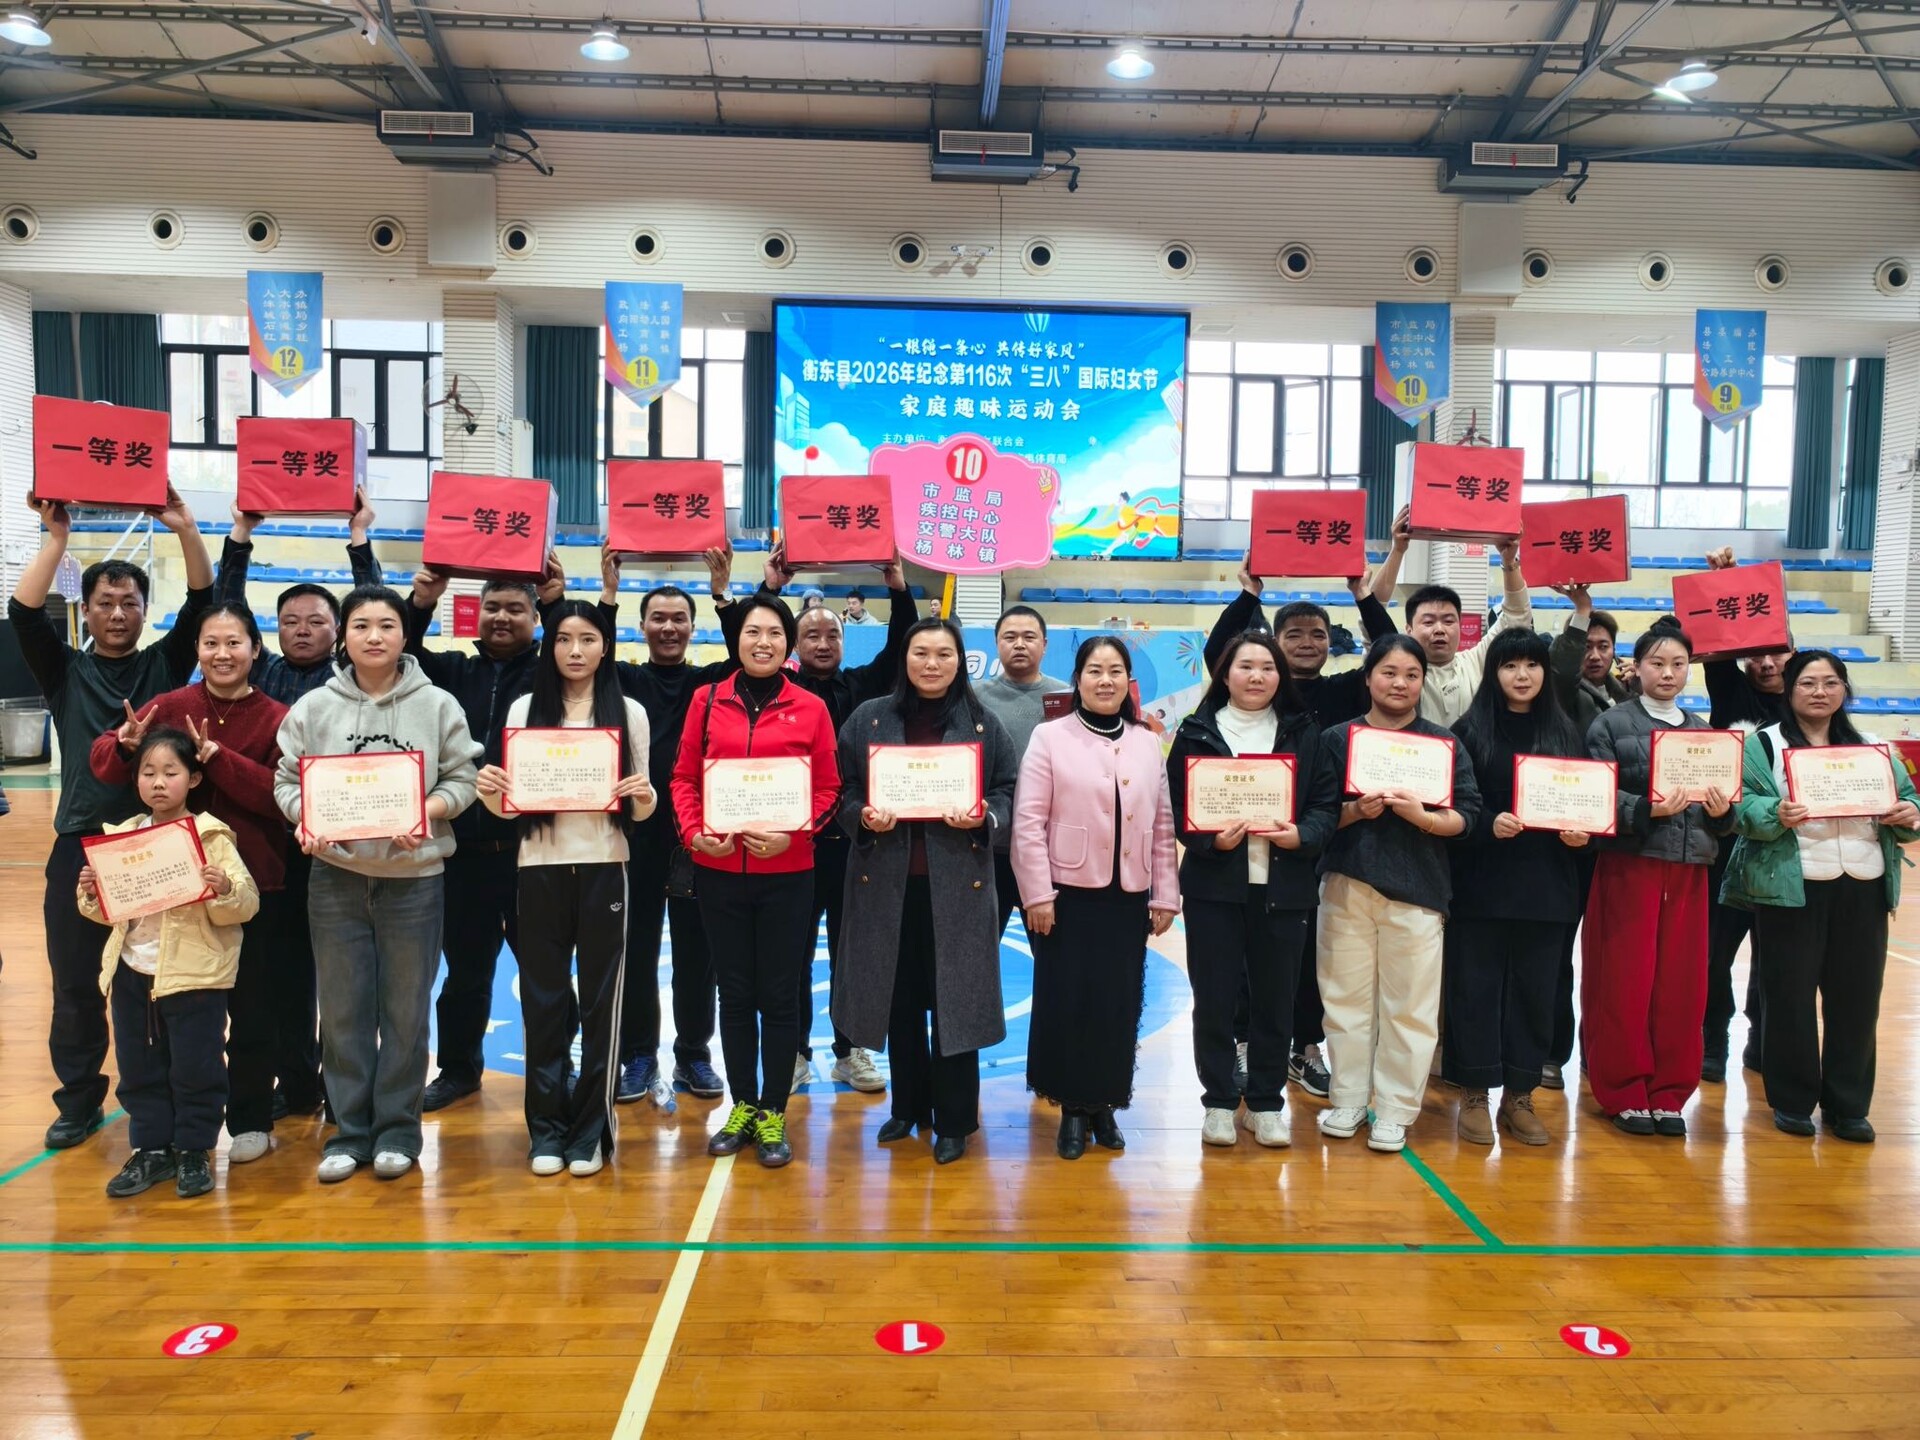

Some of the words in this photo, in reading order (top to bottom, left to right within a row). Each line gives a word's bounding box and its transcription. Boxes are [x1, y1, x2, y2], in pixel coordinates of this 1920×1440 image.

[263, 288, 307, 299] 人大办
[279, 348, 296, 368] 12
[635, 359, 650, 378] 11
[1403, 378, 1421, 397] 10
[1720, 384, 1733, 403] 9
[899, 393, 1081, 421] 家庭趣味运动会
[53, 437, 152, 468] 一等奖
[252, 450, 339, 477] 一等奖
[953, 447, 983, 481] 10
[923, 482, 1003, 507] 市监局
[1427, 475, 1510, 502] 一等奖
[623, 493, 710, 519] 一等奖
[797, 505, 880, 530] 一等奖
[919, 502, 1001, 526] 疾控中心
[441, 507, 531, 538] 一等奖
[918, 520, 998, 545] 交警大队
[1266, 519, 1352, 545] 一等奖
[915, 539, 996, 563] 杨林镇
[1532, 527, 1612, 555] 一等奖
[1688, 592, 1770, 620] 一等奖
[1224, 774, 1256, 783] 荣誉证书
[174, 1325, 224, 1355] 3
[902, 1323, 928, 1351] 1
[1569, 1326, 1618, 1355] 2
